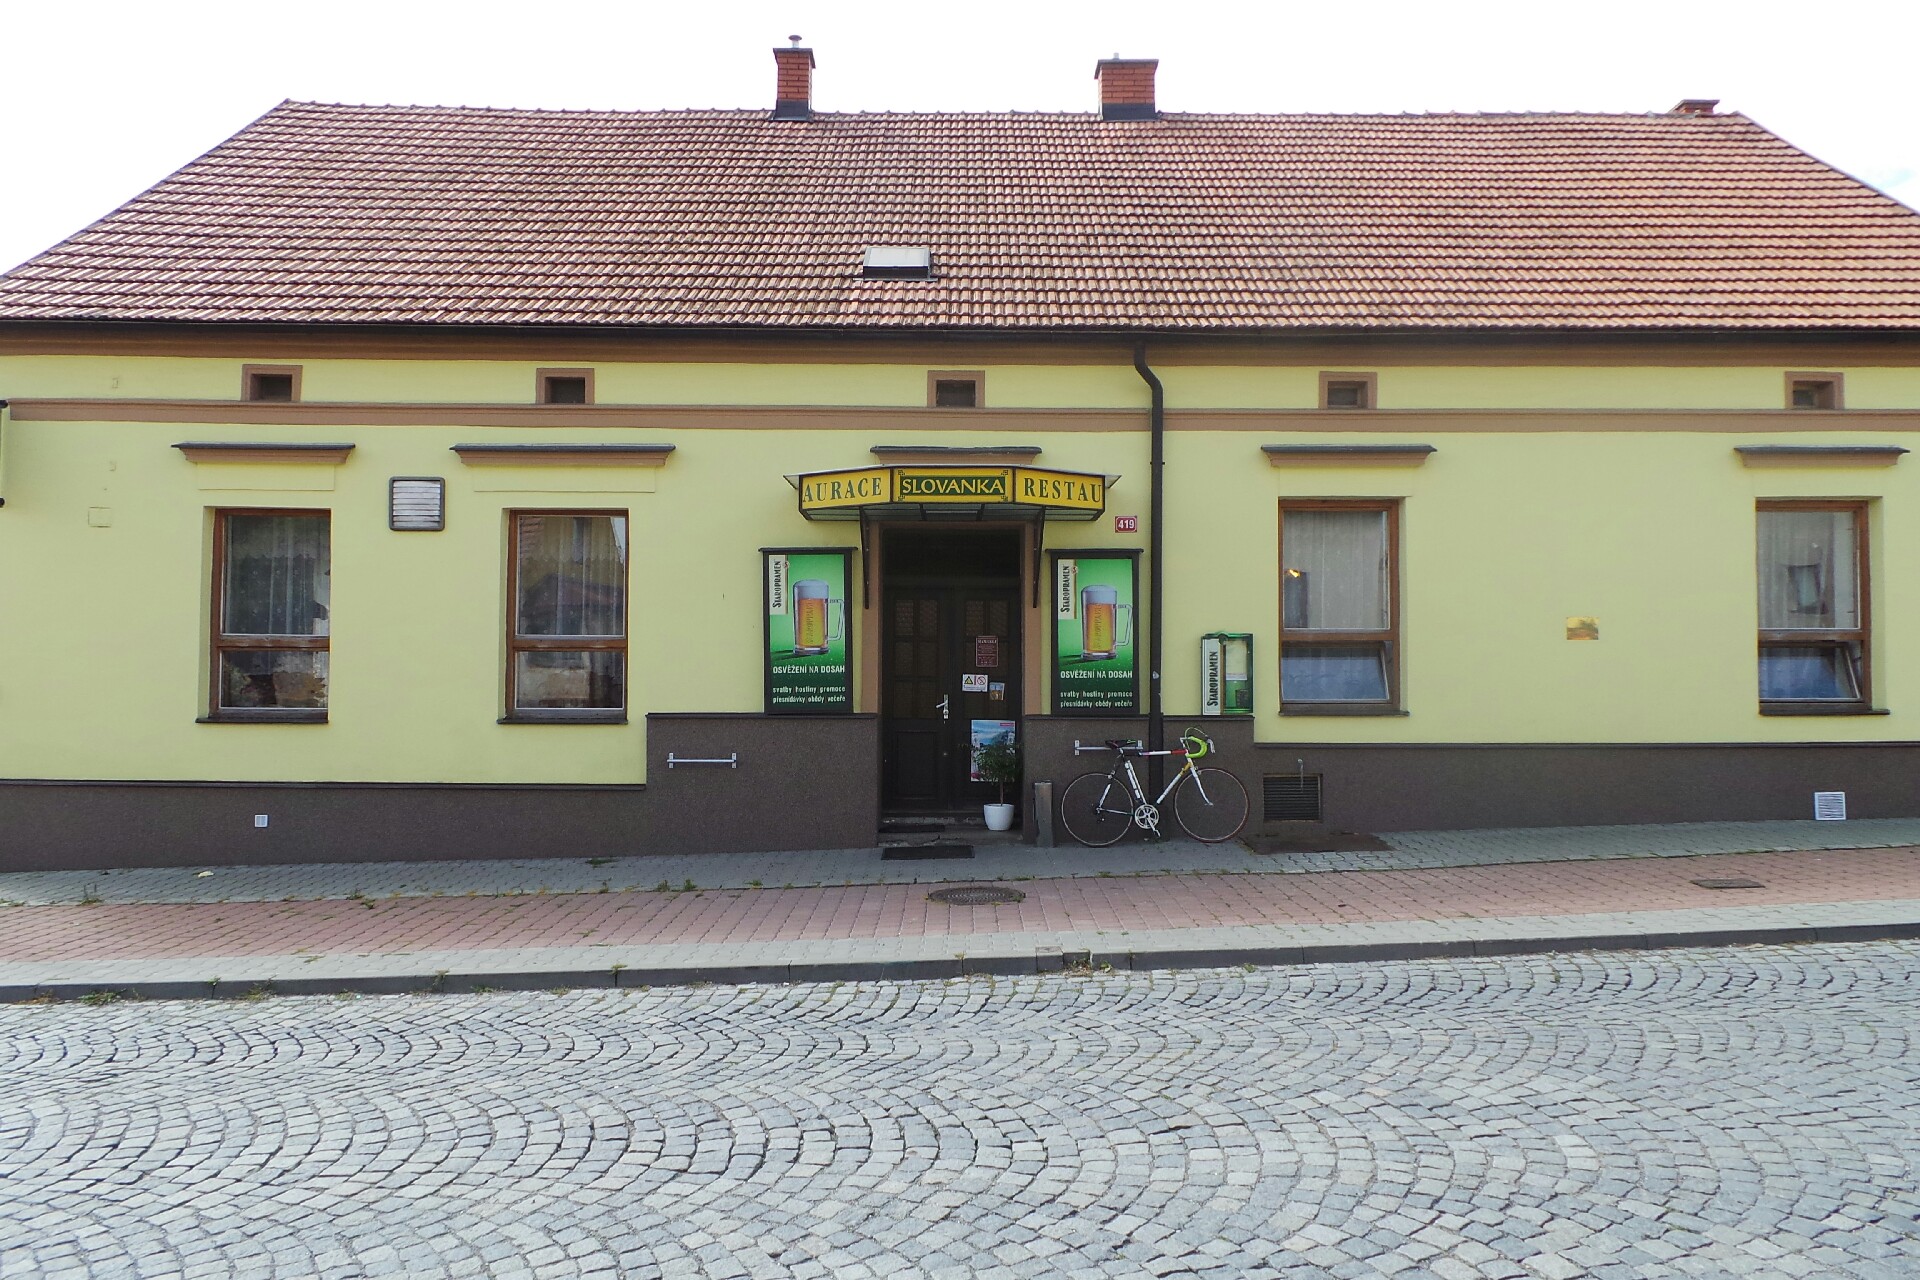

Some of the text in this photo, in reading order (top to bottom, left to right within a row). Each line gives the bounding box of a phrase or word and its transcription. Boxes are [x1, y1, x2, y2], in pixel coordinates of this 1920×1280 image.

[803, 478, 882, 502] AURACE
[902, 478, 1004, 494] SLOVANKA
[1024, 477, 1101, 503] RESTAU
[1118, 519, 1135, 529] 419
[809, 665, 819, 674] NA
[821, 665, 845, 674] DOSAH
[1097, 670, 1107, 679] NA
[1108, 670, 1133, 679] DOSAH
[1206, 651, 1219, 706] STAROPRAMEN
